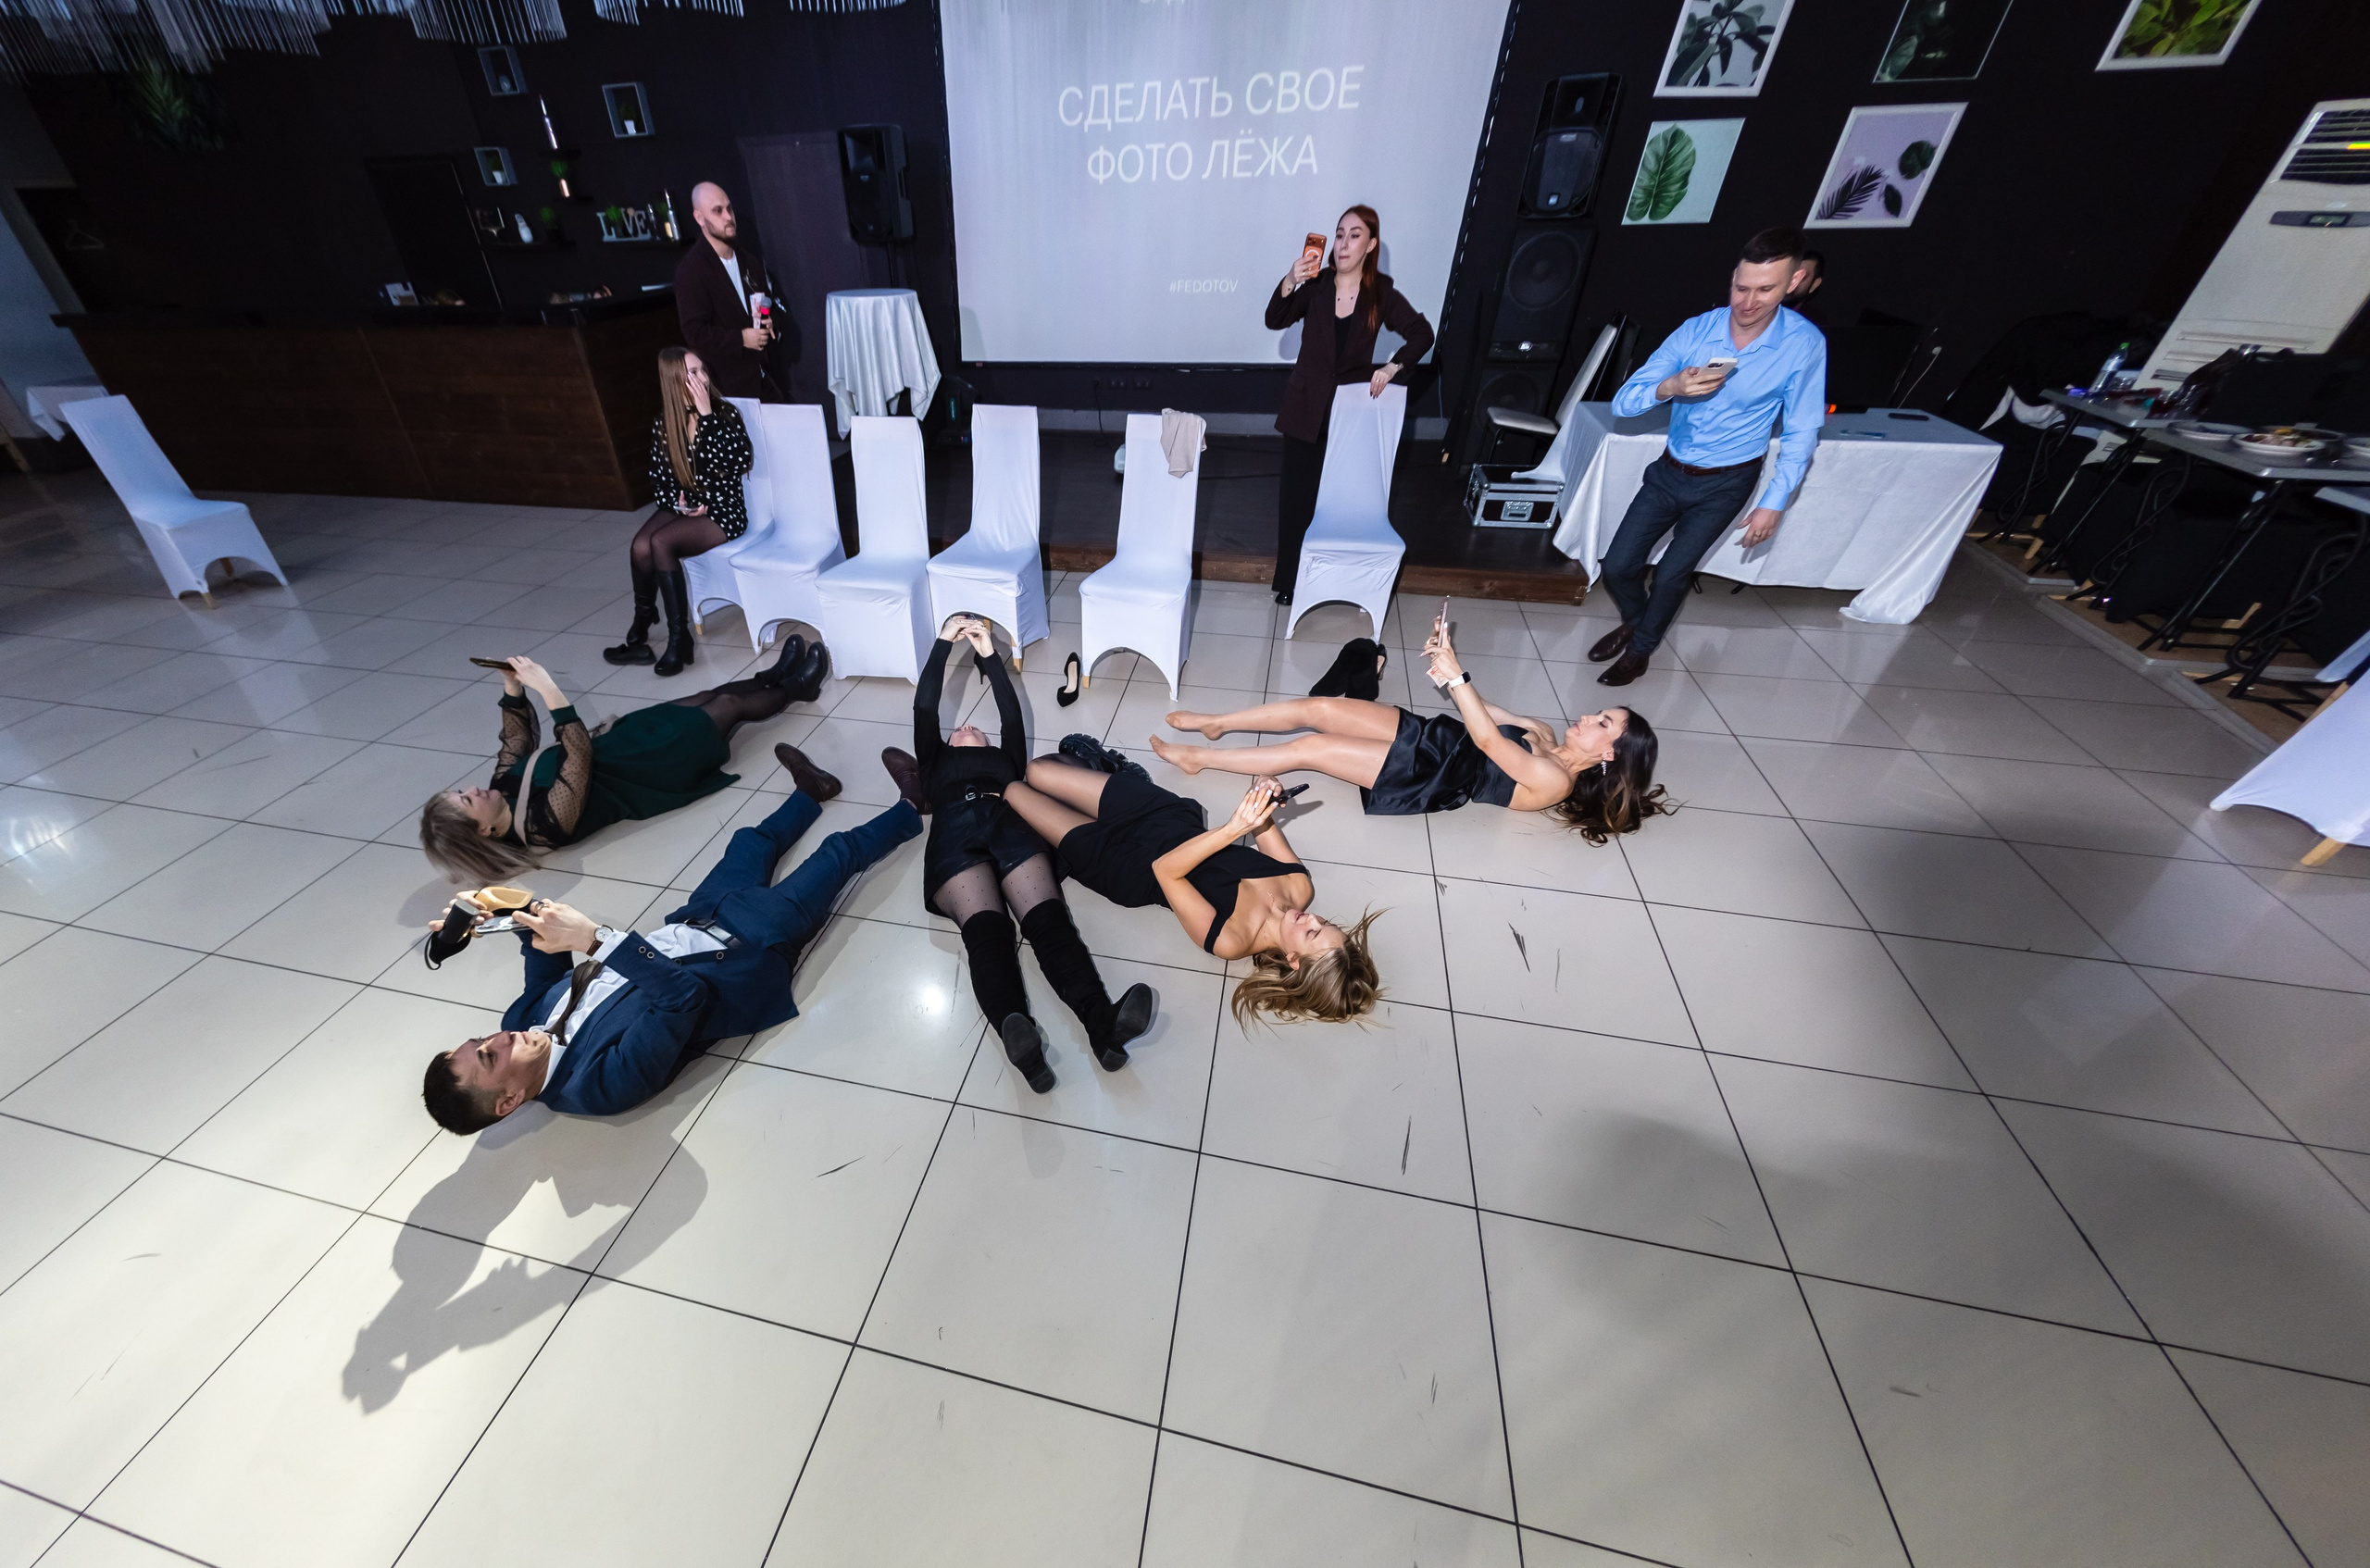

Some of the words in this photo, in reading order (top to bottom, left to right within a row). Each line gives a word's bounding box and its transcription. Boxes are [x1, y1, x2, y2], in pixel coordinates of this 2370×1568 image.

[1058, 76, 1233, 133] СДЕЛАТЬ
[1245, 65, 1366, 116] СВОЕ
[1087, 142, 1193, 185] ФОТО
[1201, 128, 1318, 180] ЛЁЖА
[596, 207, 652, 243] LVE
[1169, 279, 1239, 293] #FEDOTOV
